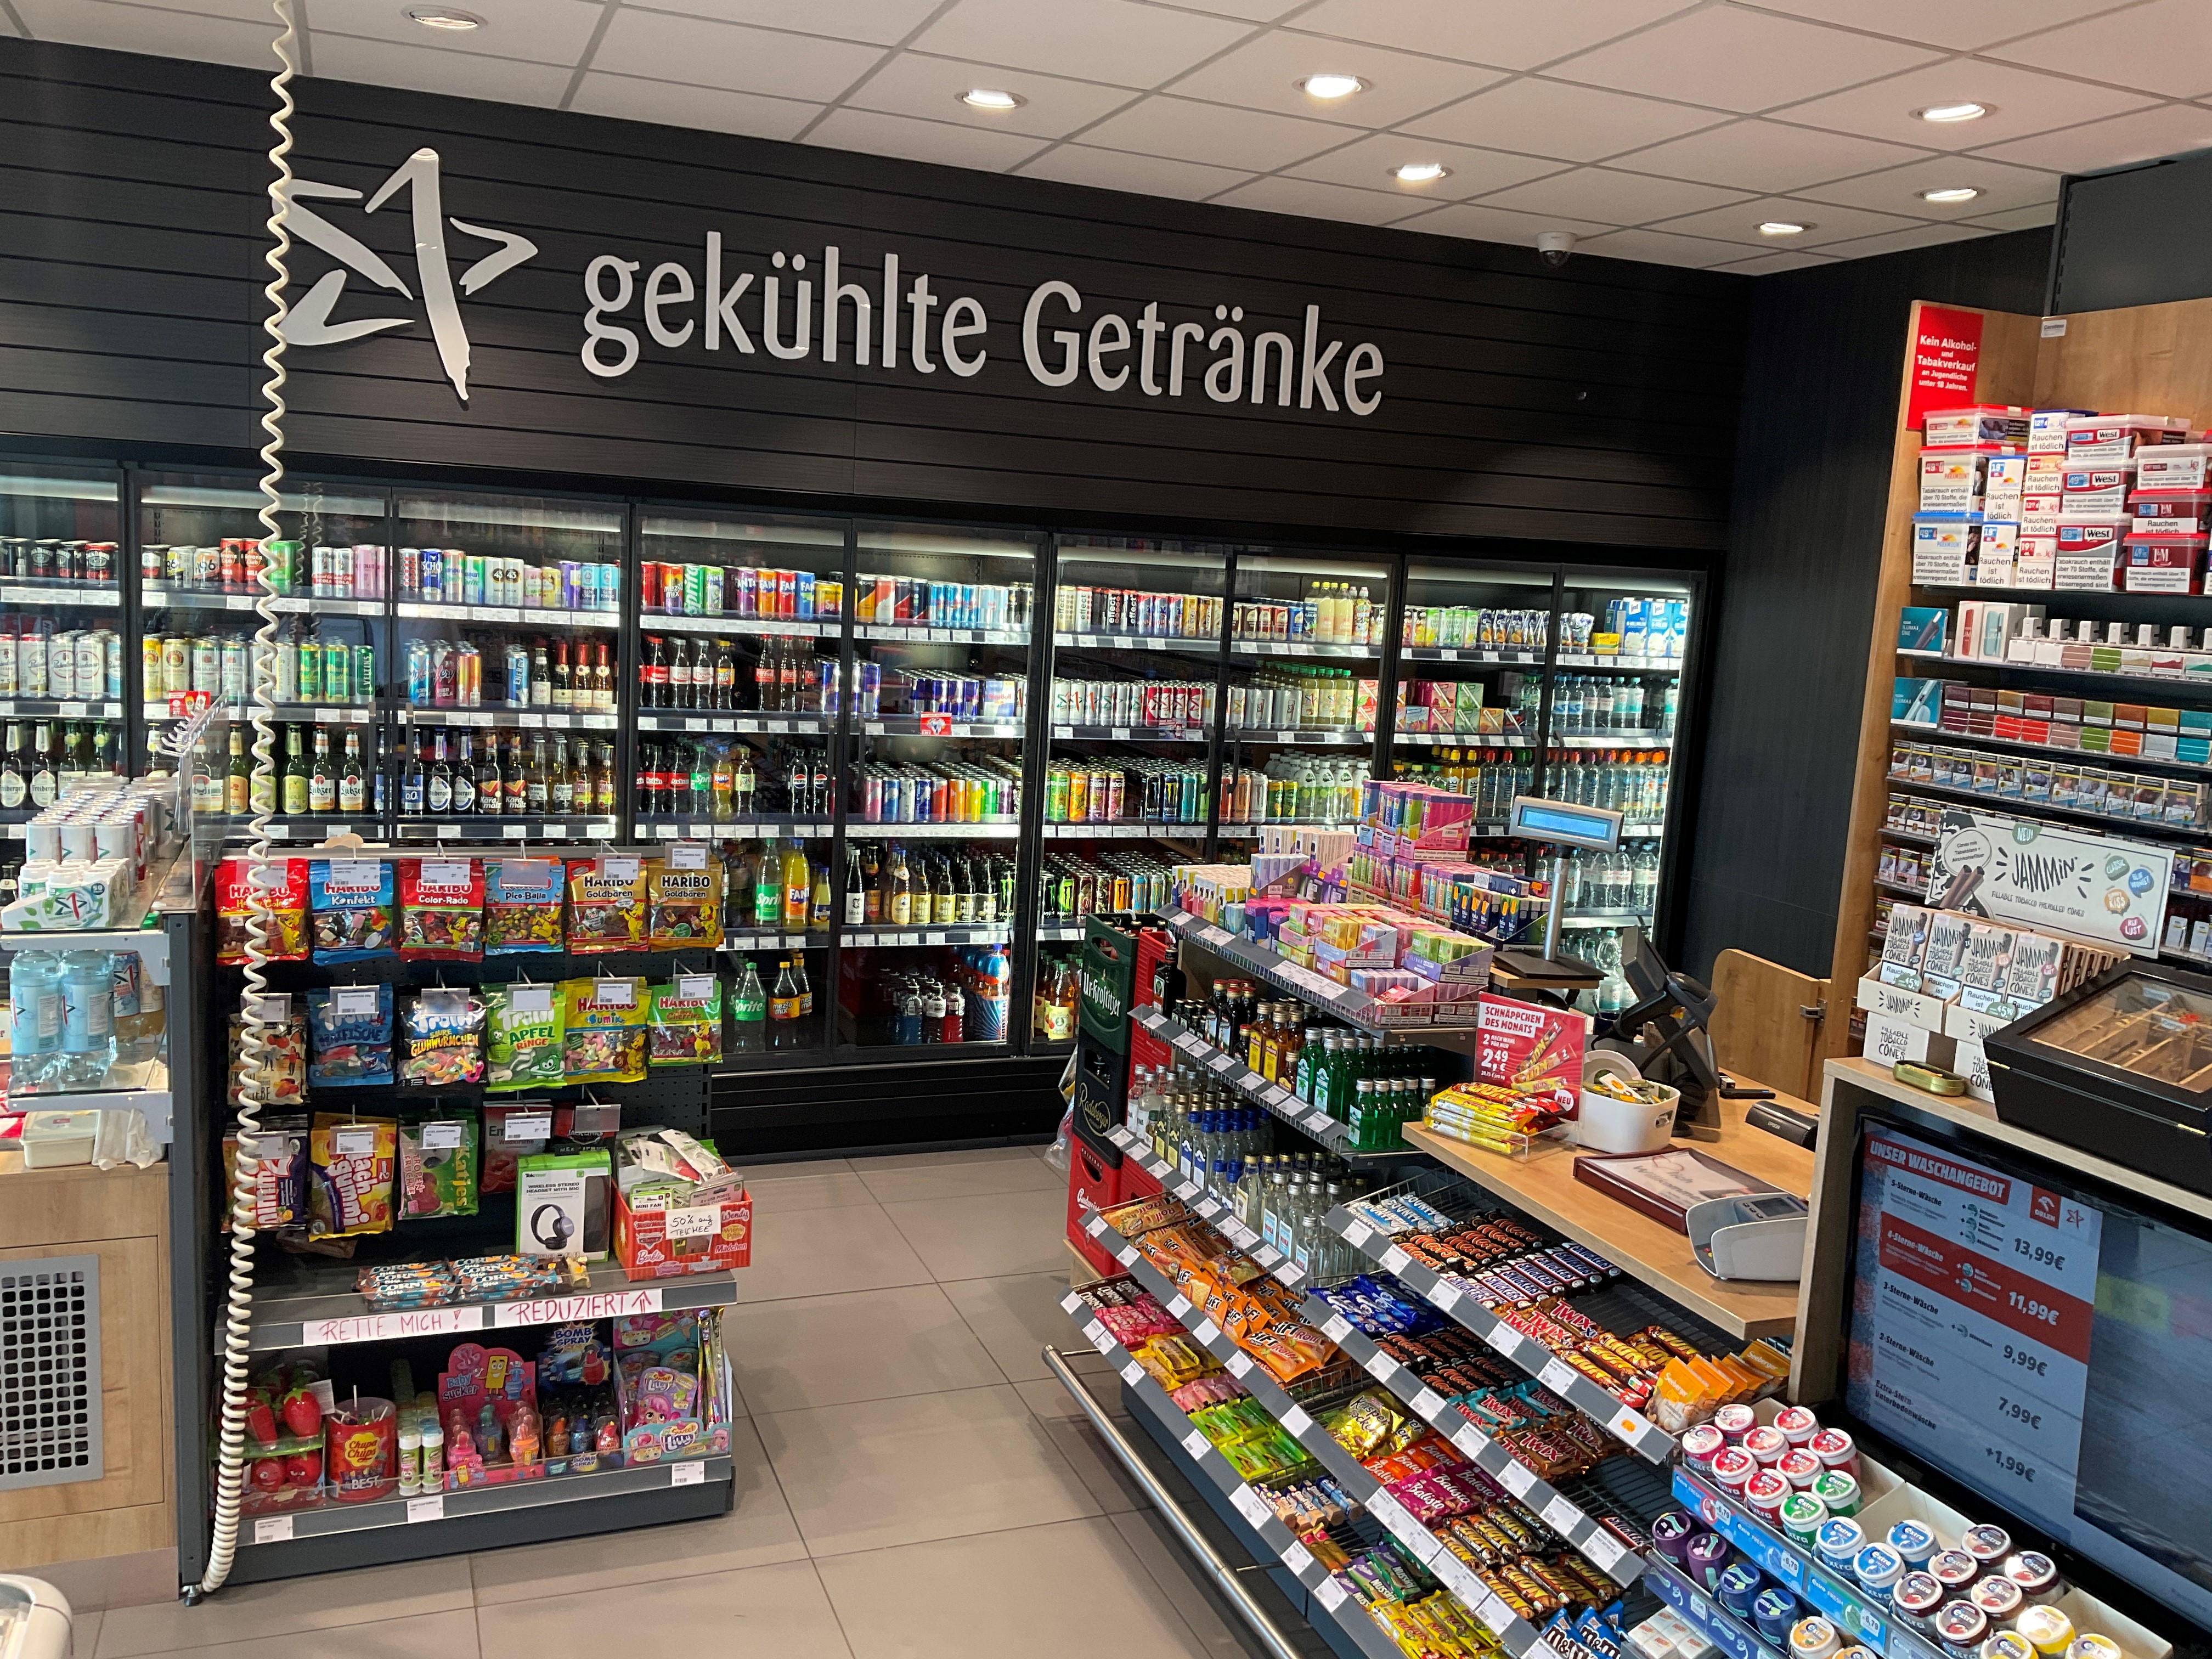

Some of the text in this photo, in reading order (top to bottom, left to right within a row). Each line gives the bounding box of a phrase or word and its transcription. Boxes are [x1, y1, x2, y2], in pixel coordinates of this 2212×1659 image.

[582, 230, 1385, 415] gekühlte Getränke
[1920, 335, 1977, 352] Kein Alkohol-
[1917, 355, 1976, 371] Tabakverkauf
[1932, 371, 1968, 382] Jugendliche
[1945, 383, 1968, 391] Jahren.
[2095, 475, 2117, 483] West
[2087, 529, 2109, 538] West
[481, 796, 496, 804] Kara
[506, 796, 522, 804] Kara
[2017, 827, 2034, 842] NEU!
[584, 876, 635, 887] HARIBO
[662, 876, 710, 888] HARIBO
[331, 895, 376, 905] Konfekt
[419, 894, 469, 905] Color-Rado
[505, 891, 546, 900] Pico-Balla
[586, 889, 633, 898] Goldbären
[664, 889, 706, 899] Goldbären
[1991, 891, 2013, 902] FILLABLE
[2015, 896, 2037, 907] TOBACCO
[2125, 924, 2141, 936] LUST
[1884, 949, 1907, 962] CONES
[1965, 973, 1989, 987] CONES
[2010, 982, 2035, 997] CONES
[734, 998, 765, 1012] Sprite
[772, 1001, 792, 1010] mezzo
[1485, 1006, 1542, 1024] SCHNÄPPCHEN
[1485, 1017, 1533, 1034] DES MONATS
[1882, 1026, 1909, 1039] FILLABLE
[430, 1029, 452, 1039] SAURE
[509, 1025, 555, 1045] APFEL
[1483, 1034, 1490, 1045] 2
[1881, 1032, 1908, 1046] TOBACCO
[410, 1032, 478, 1057] GLÜHWÜRMCHEN
[1078, 1082, 1109, 1133] Radeberger
[1557, 1095, 1572, 1105] NEU
[412, 1153, 424, 1193] TROPEN-
[453, 1147, 470, 1207] Katjes
[1870, 1141, 2005, 1198] UNSER WASCHANGEBOT
[1891, 1179, 1942, 1207] 5-Sterne-Wäsche
[1402, 1194, 1437, 1216] BOUNTY
[670, 1215, 693, 1227] 50%
[722, 1208, 749, 1222] Wendy
[2034, 1209, 2056, 1222] ORLEN
[715, 1242, 747, 1254] Mädchen
[1163, 1238, 1181, 1251] BiFi
[1887, 1230, 1944, 1262] 4-Sterne-Wäsche
[637, 1250, 665, 1263] Barbie
[2015, 1238, 2066, 1271] 13,99€
[1485, 1277, 1526, 1301] SNICKERS
[1503, 1271, 1544, 1295] SNICKERS
[1883, 1282, 1939, 1315] 3-Sterne-Wäsche
[508, 1291, 629, 1324] REDUZIERT
[2008, 1291, 2059, 1327] 11,99€
[318, 1316, 386, 1342] RETTE
[400, 1314, 442, 1334] MICH
[555, 1327, 592, 1339] BOMB
[557, 1336, 591, 1346] SPRAY
[1245, 1330, 1278, 1347] BiFi
[1879, 1332, 1935, 1367] 2-Sterne-Wäsche
[1747, 1351, 1778, 1370] Seeberger
[2003, 1345, 2047, 1377] 9,99€
[447, 1373, 472, 1388] Baby
[1664, 1372, 1689, 1397] Seeberger
[442, 1385, 479, 1401] sucker
[1481, 1394, 1517, 1419] TWIX
[1875, 1390, 1937, 1430] Unterbodenwäsche
[1998, 1396, 2042, 1430] 7,99€
[348, 1437, 380, 1451] Chupa
[1519, 1432, 1564, 1463] TWIX
[347, 1447, 377, 1462] Chups
[351, 1475, 379, 1490] BEST
[1432, 1474, 1471, 1504] Balisto
[1408, 1481, 1446, 1510] Balisto
[1797, 1498, 1816, 1511] extra
[1751, 1535, 1767, 1549] FRESH
[1872, 1551, 1892, 1566] extra
